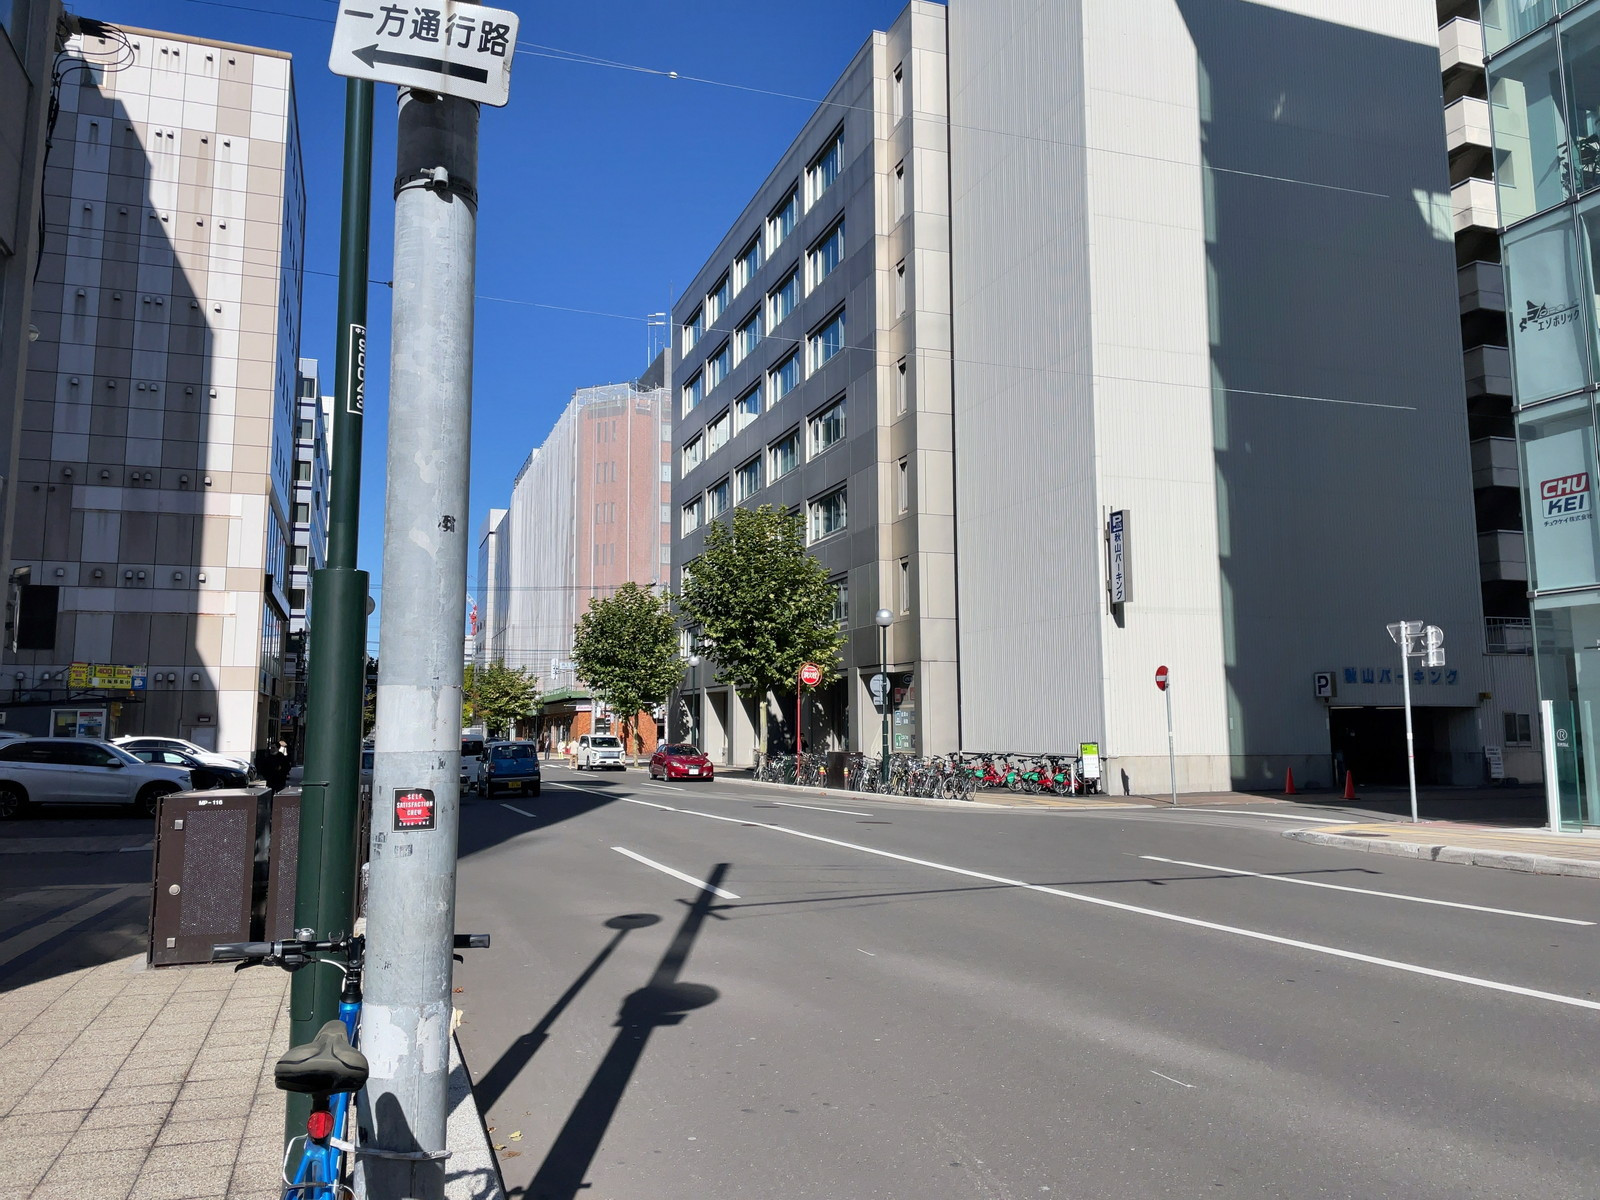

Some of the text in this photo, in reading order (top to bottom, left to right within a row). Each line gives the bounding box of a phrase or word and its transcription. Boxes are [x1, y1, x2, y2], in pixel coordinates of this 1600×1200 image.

[344, 4, 510, 57] 一方通行路
[1543, 475, 1587, 498] CHU
[1548, 494, 1584, 515] KEI
[1317, 675, 1329, 695] P
[396, 800, 434, 808] SATISFACTION
